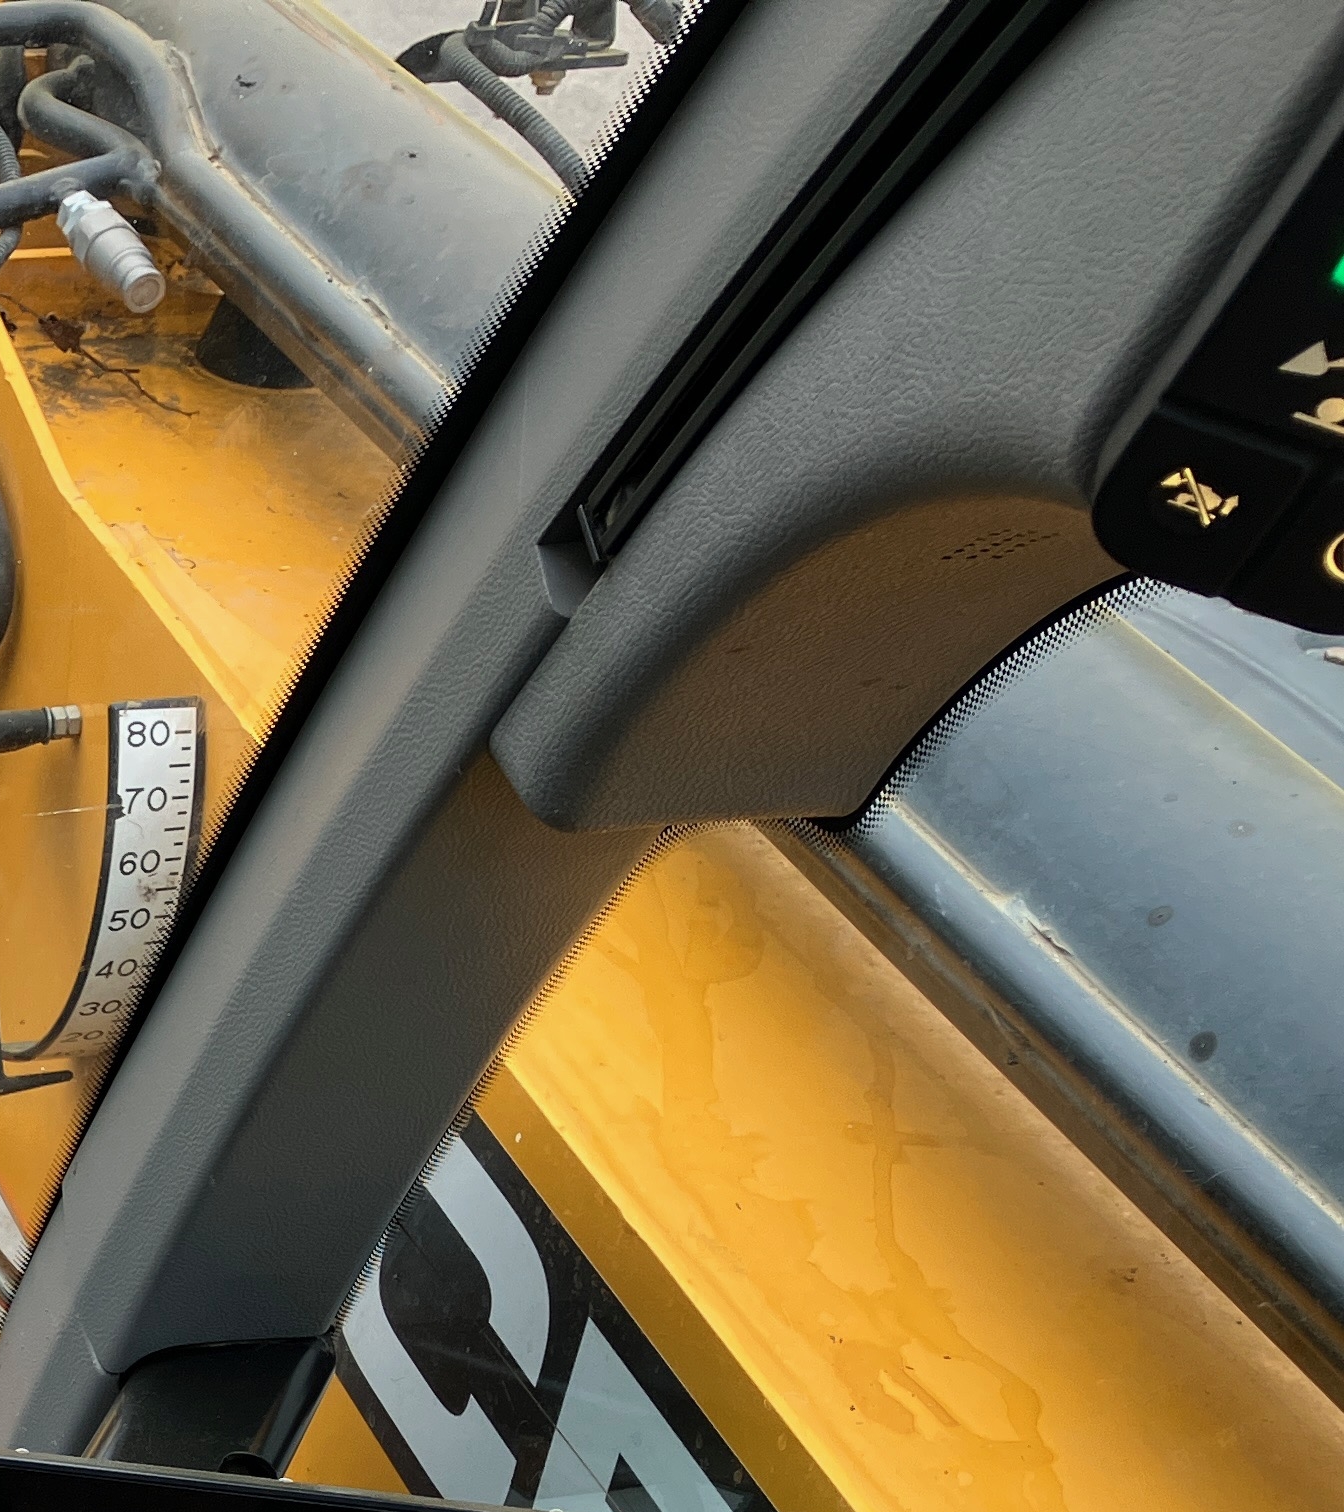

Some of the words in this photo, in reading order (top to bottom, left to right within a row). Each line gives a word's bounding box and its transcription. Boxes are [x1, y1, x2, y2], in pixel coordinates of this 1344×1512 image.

[127, 720, 170, 748] 80
[125, 786, 168, 815] 70
[119, 849, 161, 876] 60
[107, 907, 151, 932] 50
[94, 958, 138, 979] 40
[78, 999, 122, 1017] 30
[60, 1030, 104, 1044] 20
